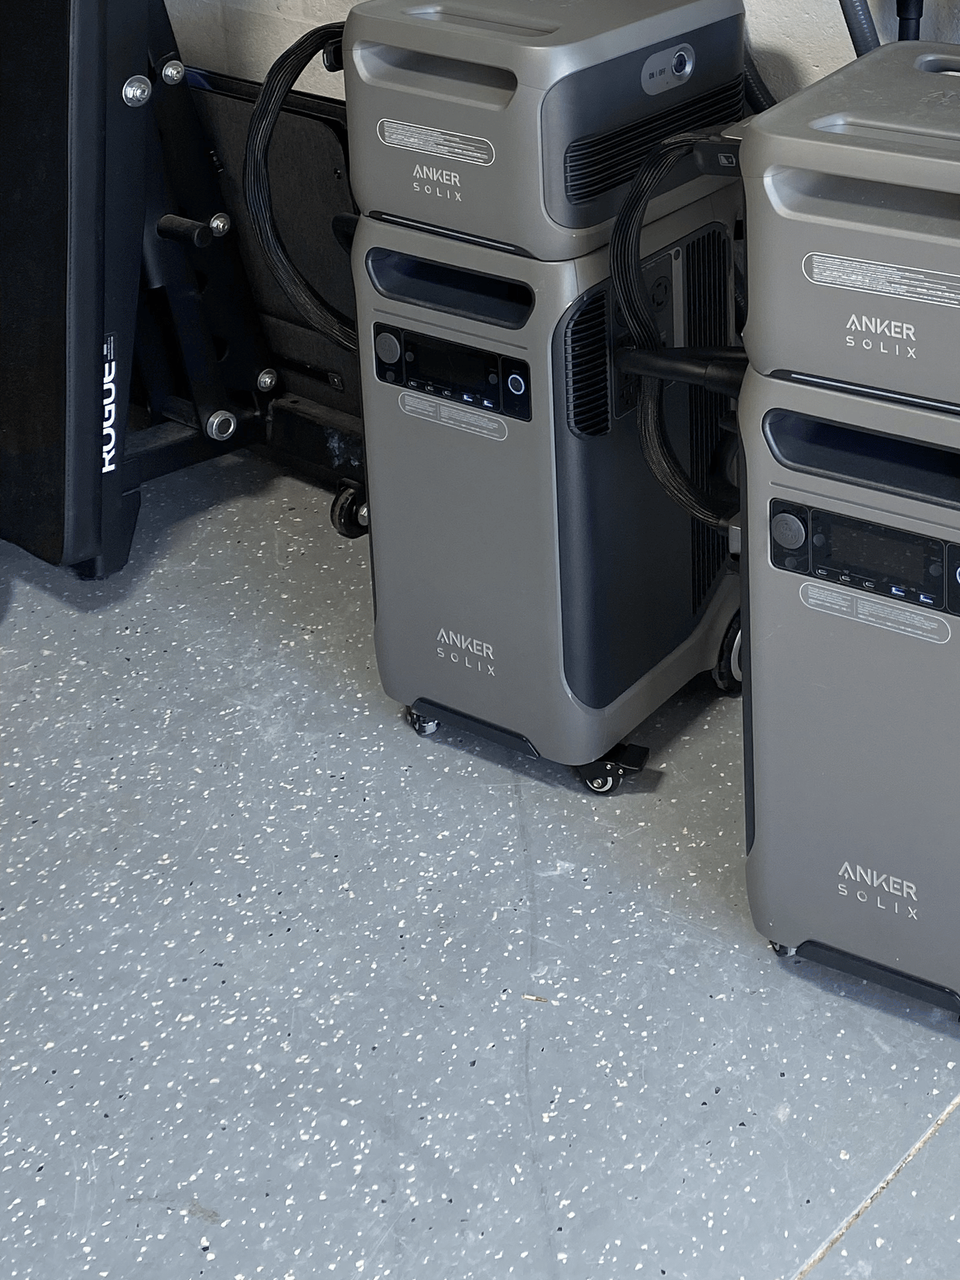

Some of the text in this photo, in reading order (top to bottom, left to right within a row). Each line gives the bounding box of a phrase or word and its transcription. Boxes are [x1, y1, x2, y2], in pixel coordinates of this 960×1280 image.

[412, 164, 461, 187] ANKER
[413, 182, 462, 201] SOLIX
[846, 313, 916, 341] ANKER
[845, 335, 917, 359] SOLIX
[101, 361, 116, 474] ROGUE
[436, 628, 494, 660] ANKER
[436, 647, 496, 677] SOLIX
[838, 861, 918, 901] ANKER
[838, 883, 918, 920] SOLIX
